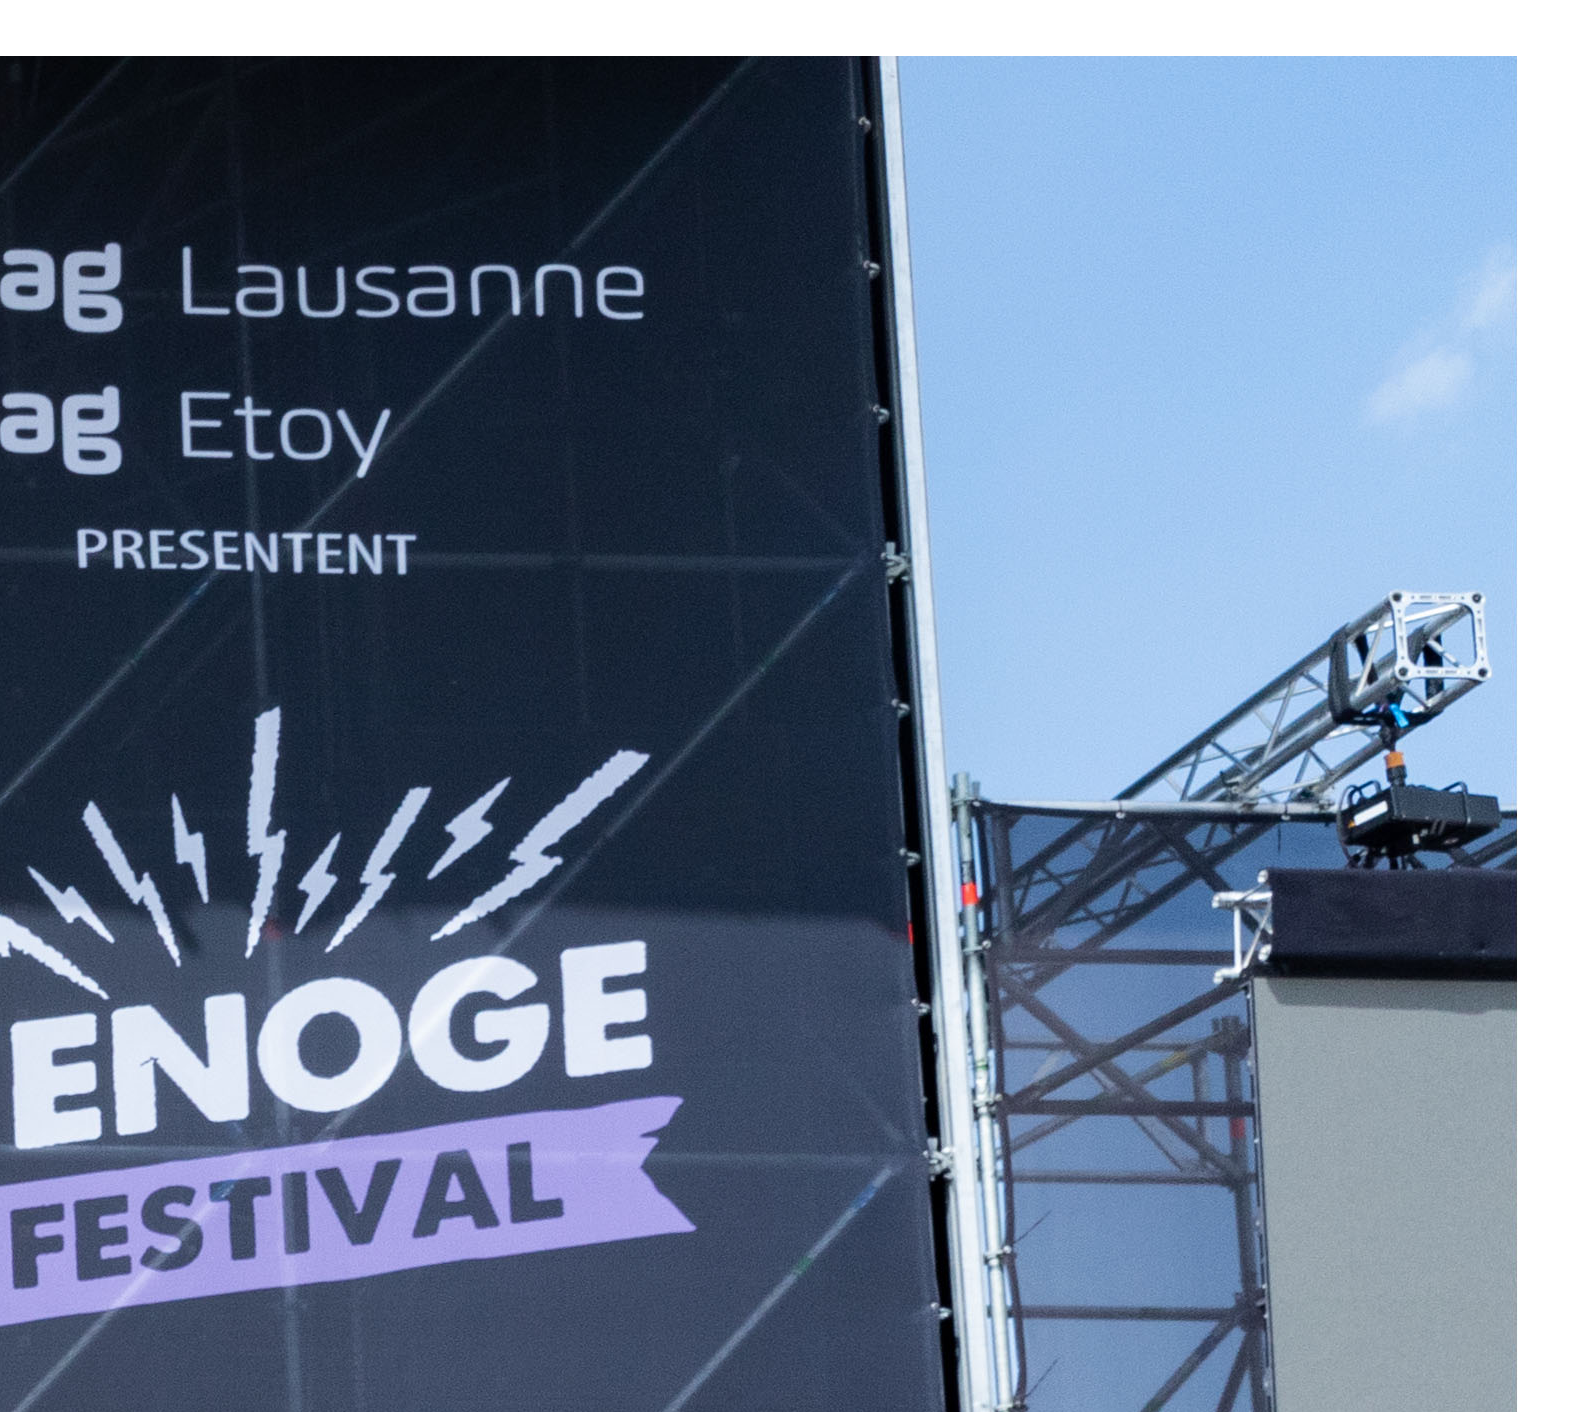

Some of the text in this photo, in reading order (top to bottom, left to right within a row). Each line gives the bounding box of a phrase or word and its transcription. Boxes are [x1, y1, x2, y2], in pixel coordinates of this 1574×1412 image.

[182, 246, 646, 321] Lausanne
[179, 390, 392, 480] Etoy
[77, 527, 417, 576] PRESENTENT
[11, 1141, 564, 1290] FESTIVAL
